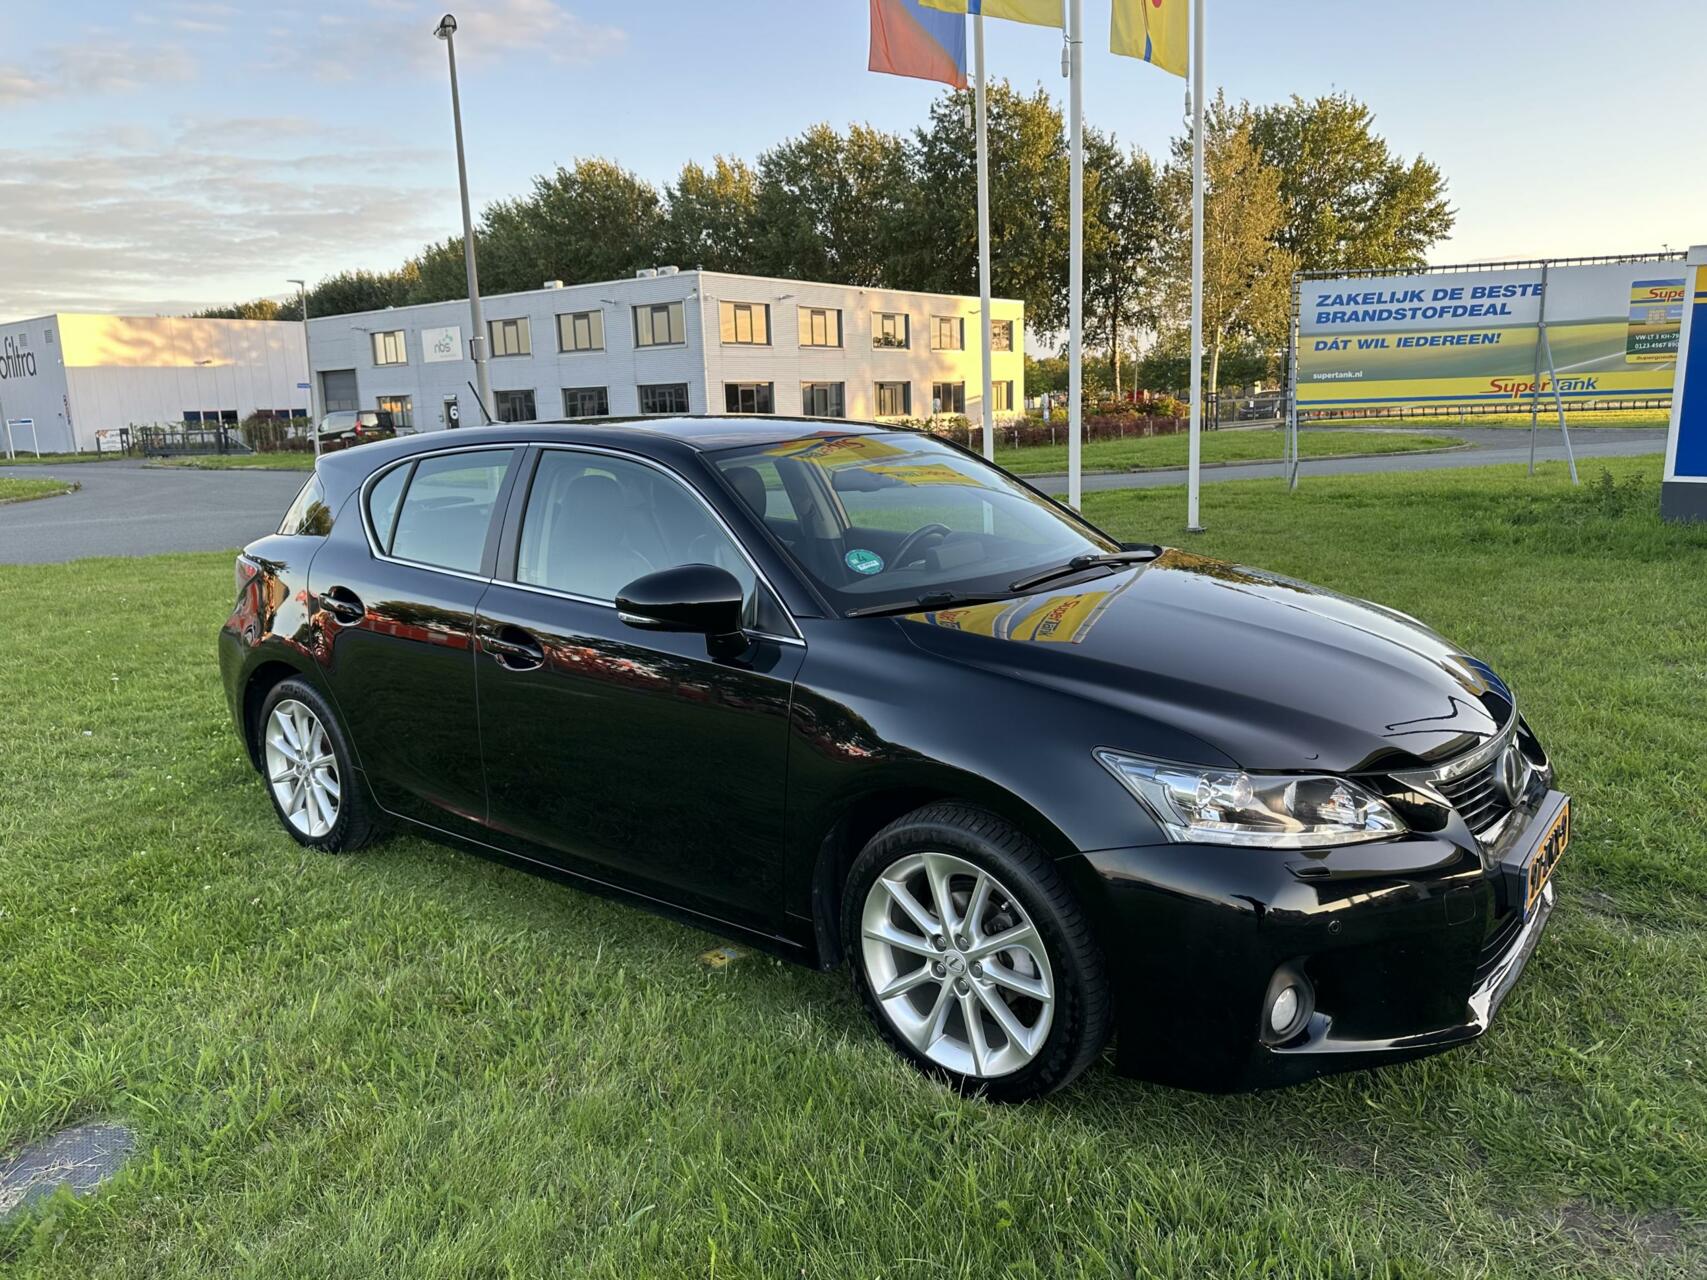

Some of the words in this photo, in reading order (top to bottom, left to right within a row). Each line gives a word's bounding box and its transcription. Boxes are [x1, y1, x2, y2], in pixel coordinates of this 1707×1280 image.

[1315, 289, 1426, 308] ZAKELIJK
[1432, 287, 1464, 302] DE
[1470, 283, 1543, 300] BESTE
[1315, 302, 1512, 325] BRANDSTOFDEAL
[1314, 337, 1352, 352] DÁT
[1357, 338, 1390, 350] WIL
[1396, 333, 1501, 349] IEDEREEN!
[1313, 370, 1363, 379] supertank.nl
[449, 405, 459, 420] 6
